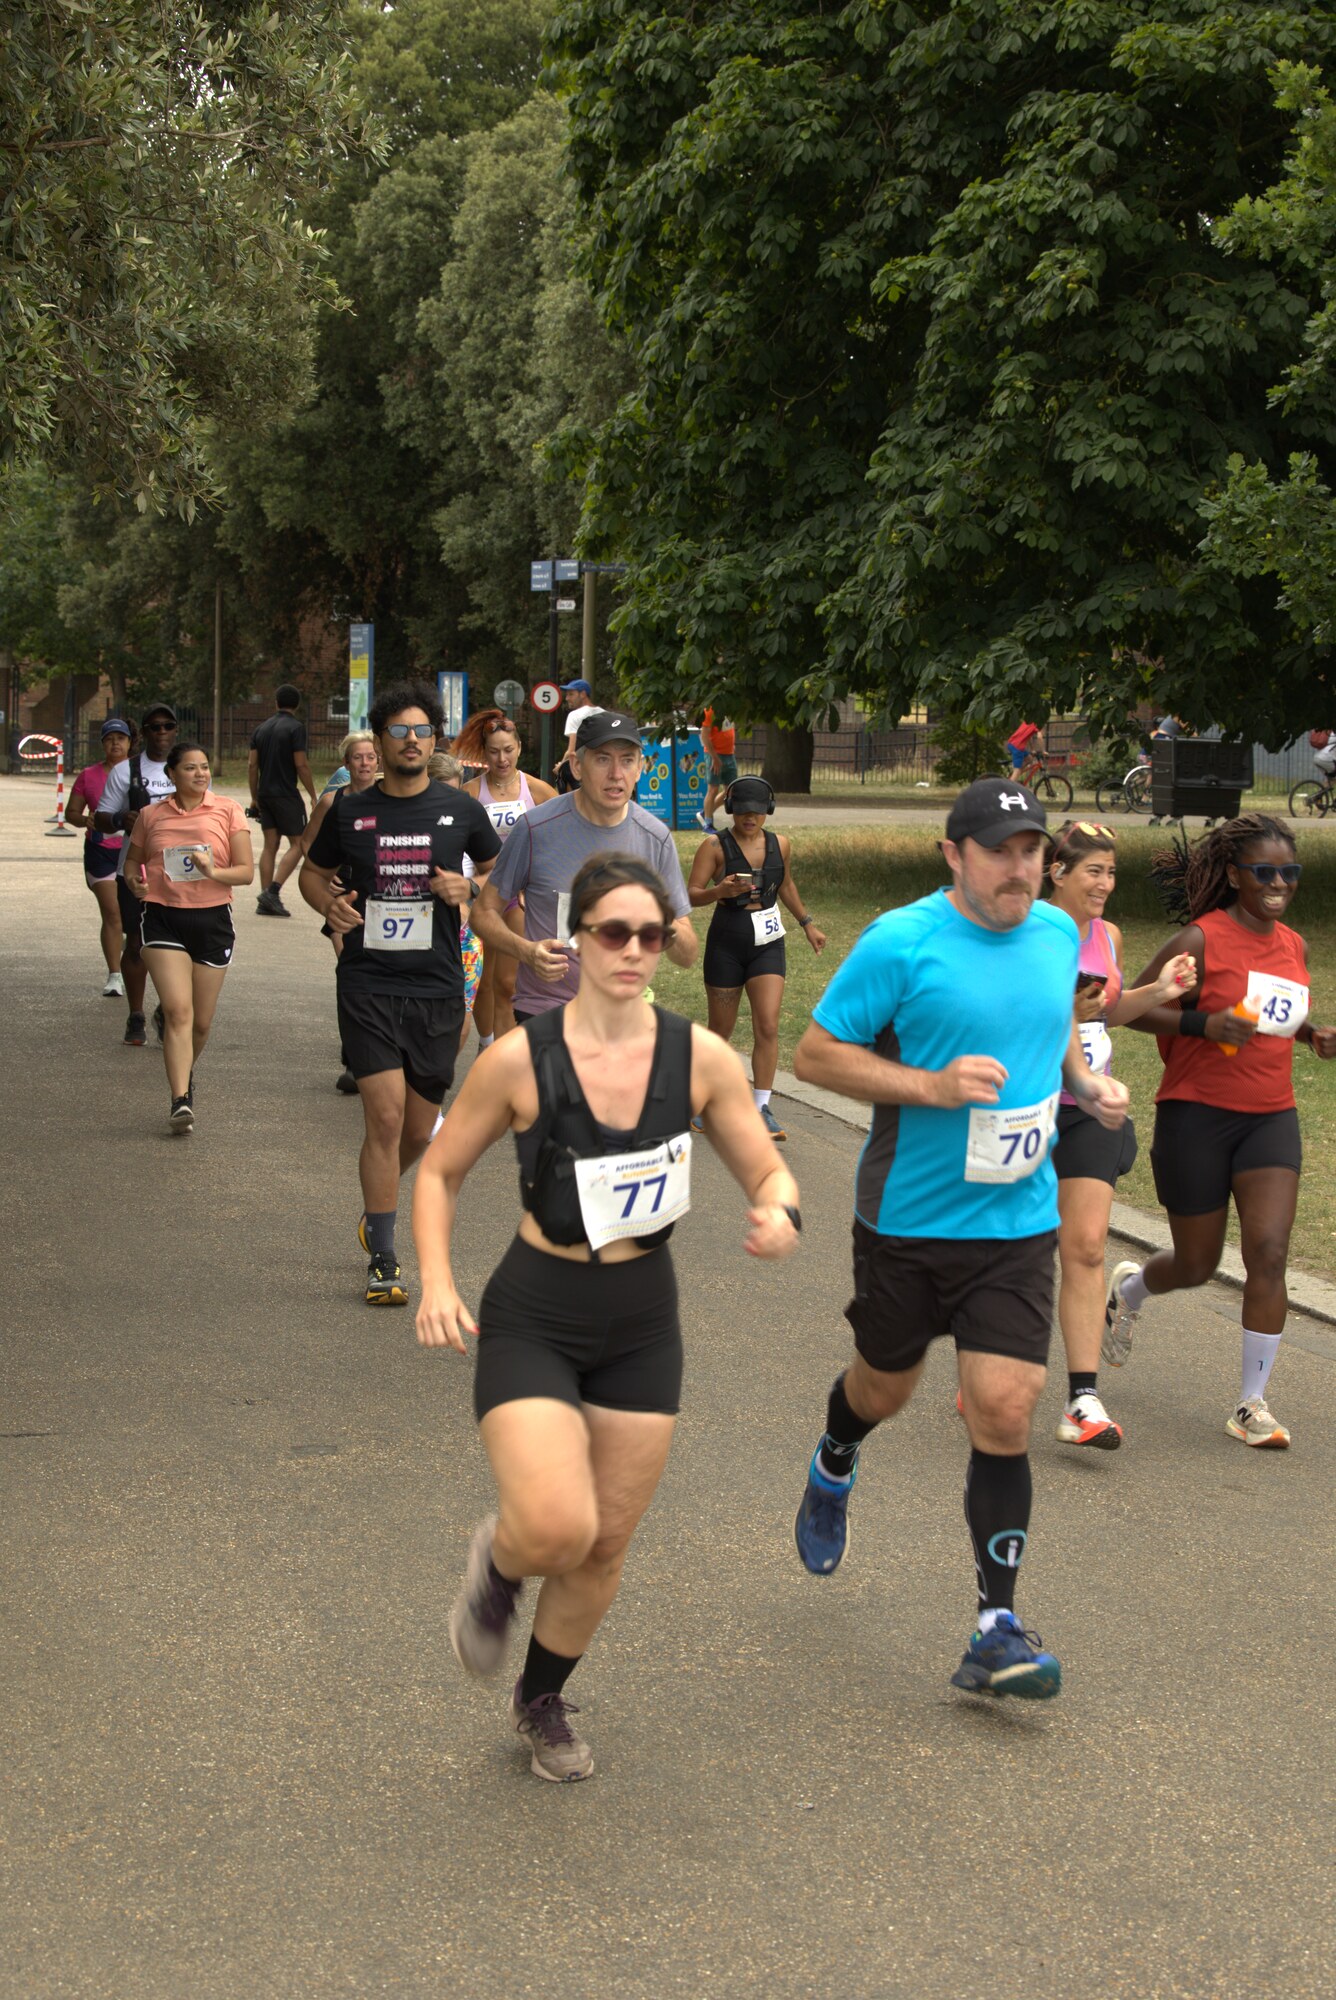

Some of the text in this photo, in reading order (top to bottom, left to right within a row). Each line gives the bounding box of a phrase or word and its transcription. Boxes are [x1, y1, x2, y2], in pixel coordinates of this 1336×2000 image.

[542, 691, 551, 704] 5
[493, 811, 515, 828] 76
[380, 836, 430, 847] FINISHER
[380, 864, 429, 875] FINISHER
[382, 918, 414, 939] 97
[765, 917, 779, 935] 58
[1263, 995, 1292, 1024] 43
[999, 1128, 1041, 1166] 70
[615, 1156, 664, 1173] AFFORDABLE
[613, 1173, 668, 1220] 77
